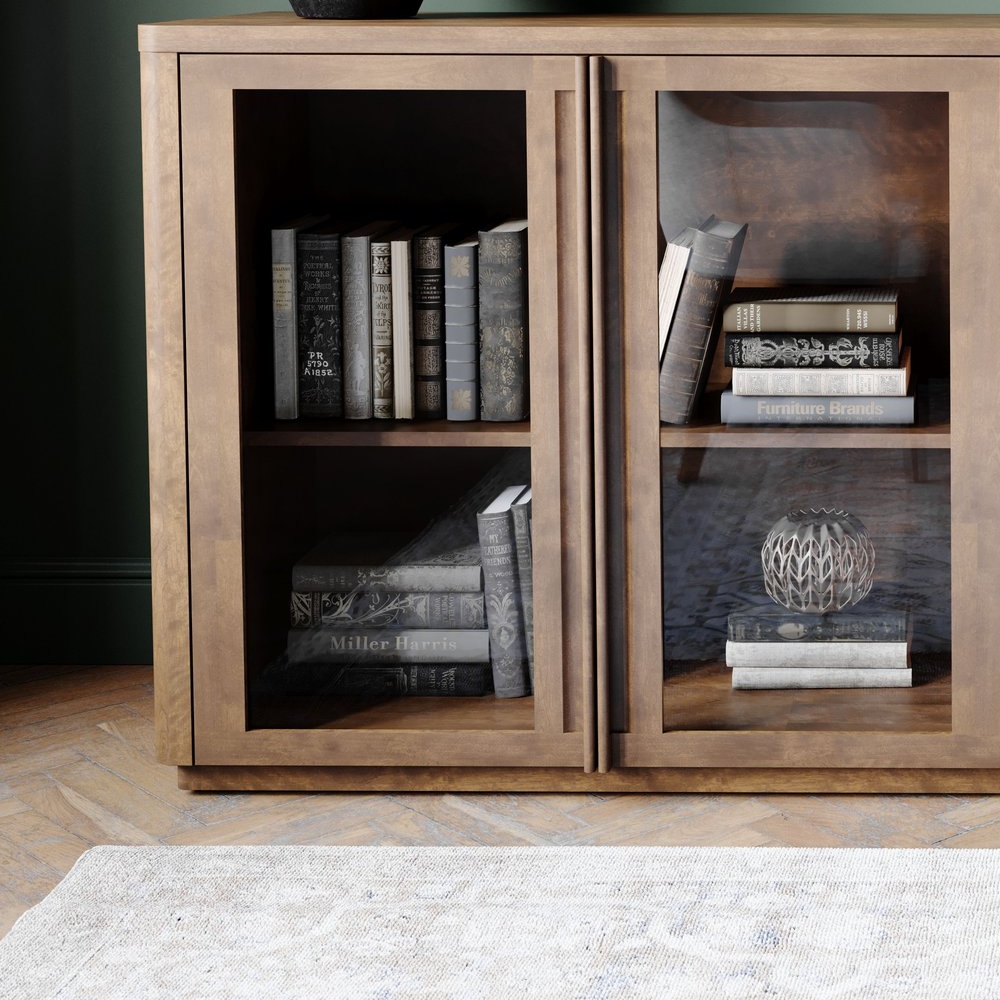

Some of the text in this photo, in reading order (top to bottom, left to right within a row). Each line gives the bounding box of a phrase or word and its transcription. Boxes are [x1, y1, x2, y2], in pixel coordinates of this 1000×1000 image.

[307, 351, 324, 361] PR
[306, 360, 329, 368] 5790
[757, 400, 884, 415] Furniture Brands
[329, 635, 457, 651] Miller Harris
